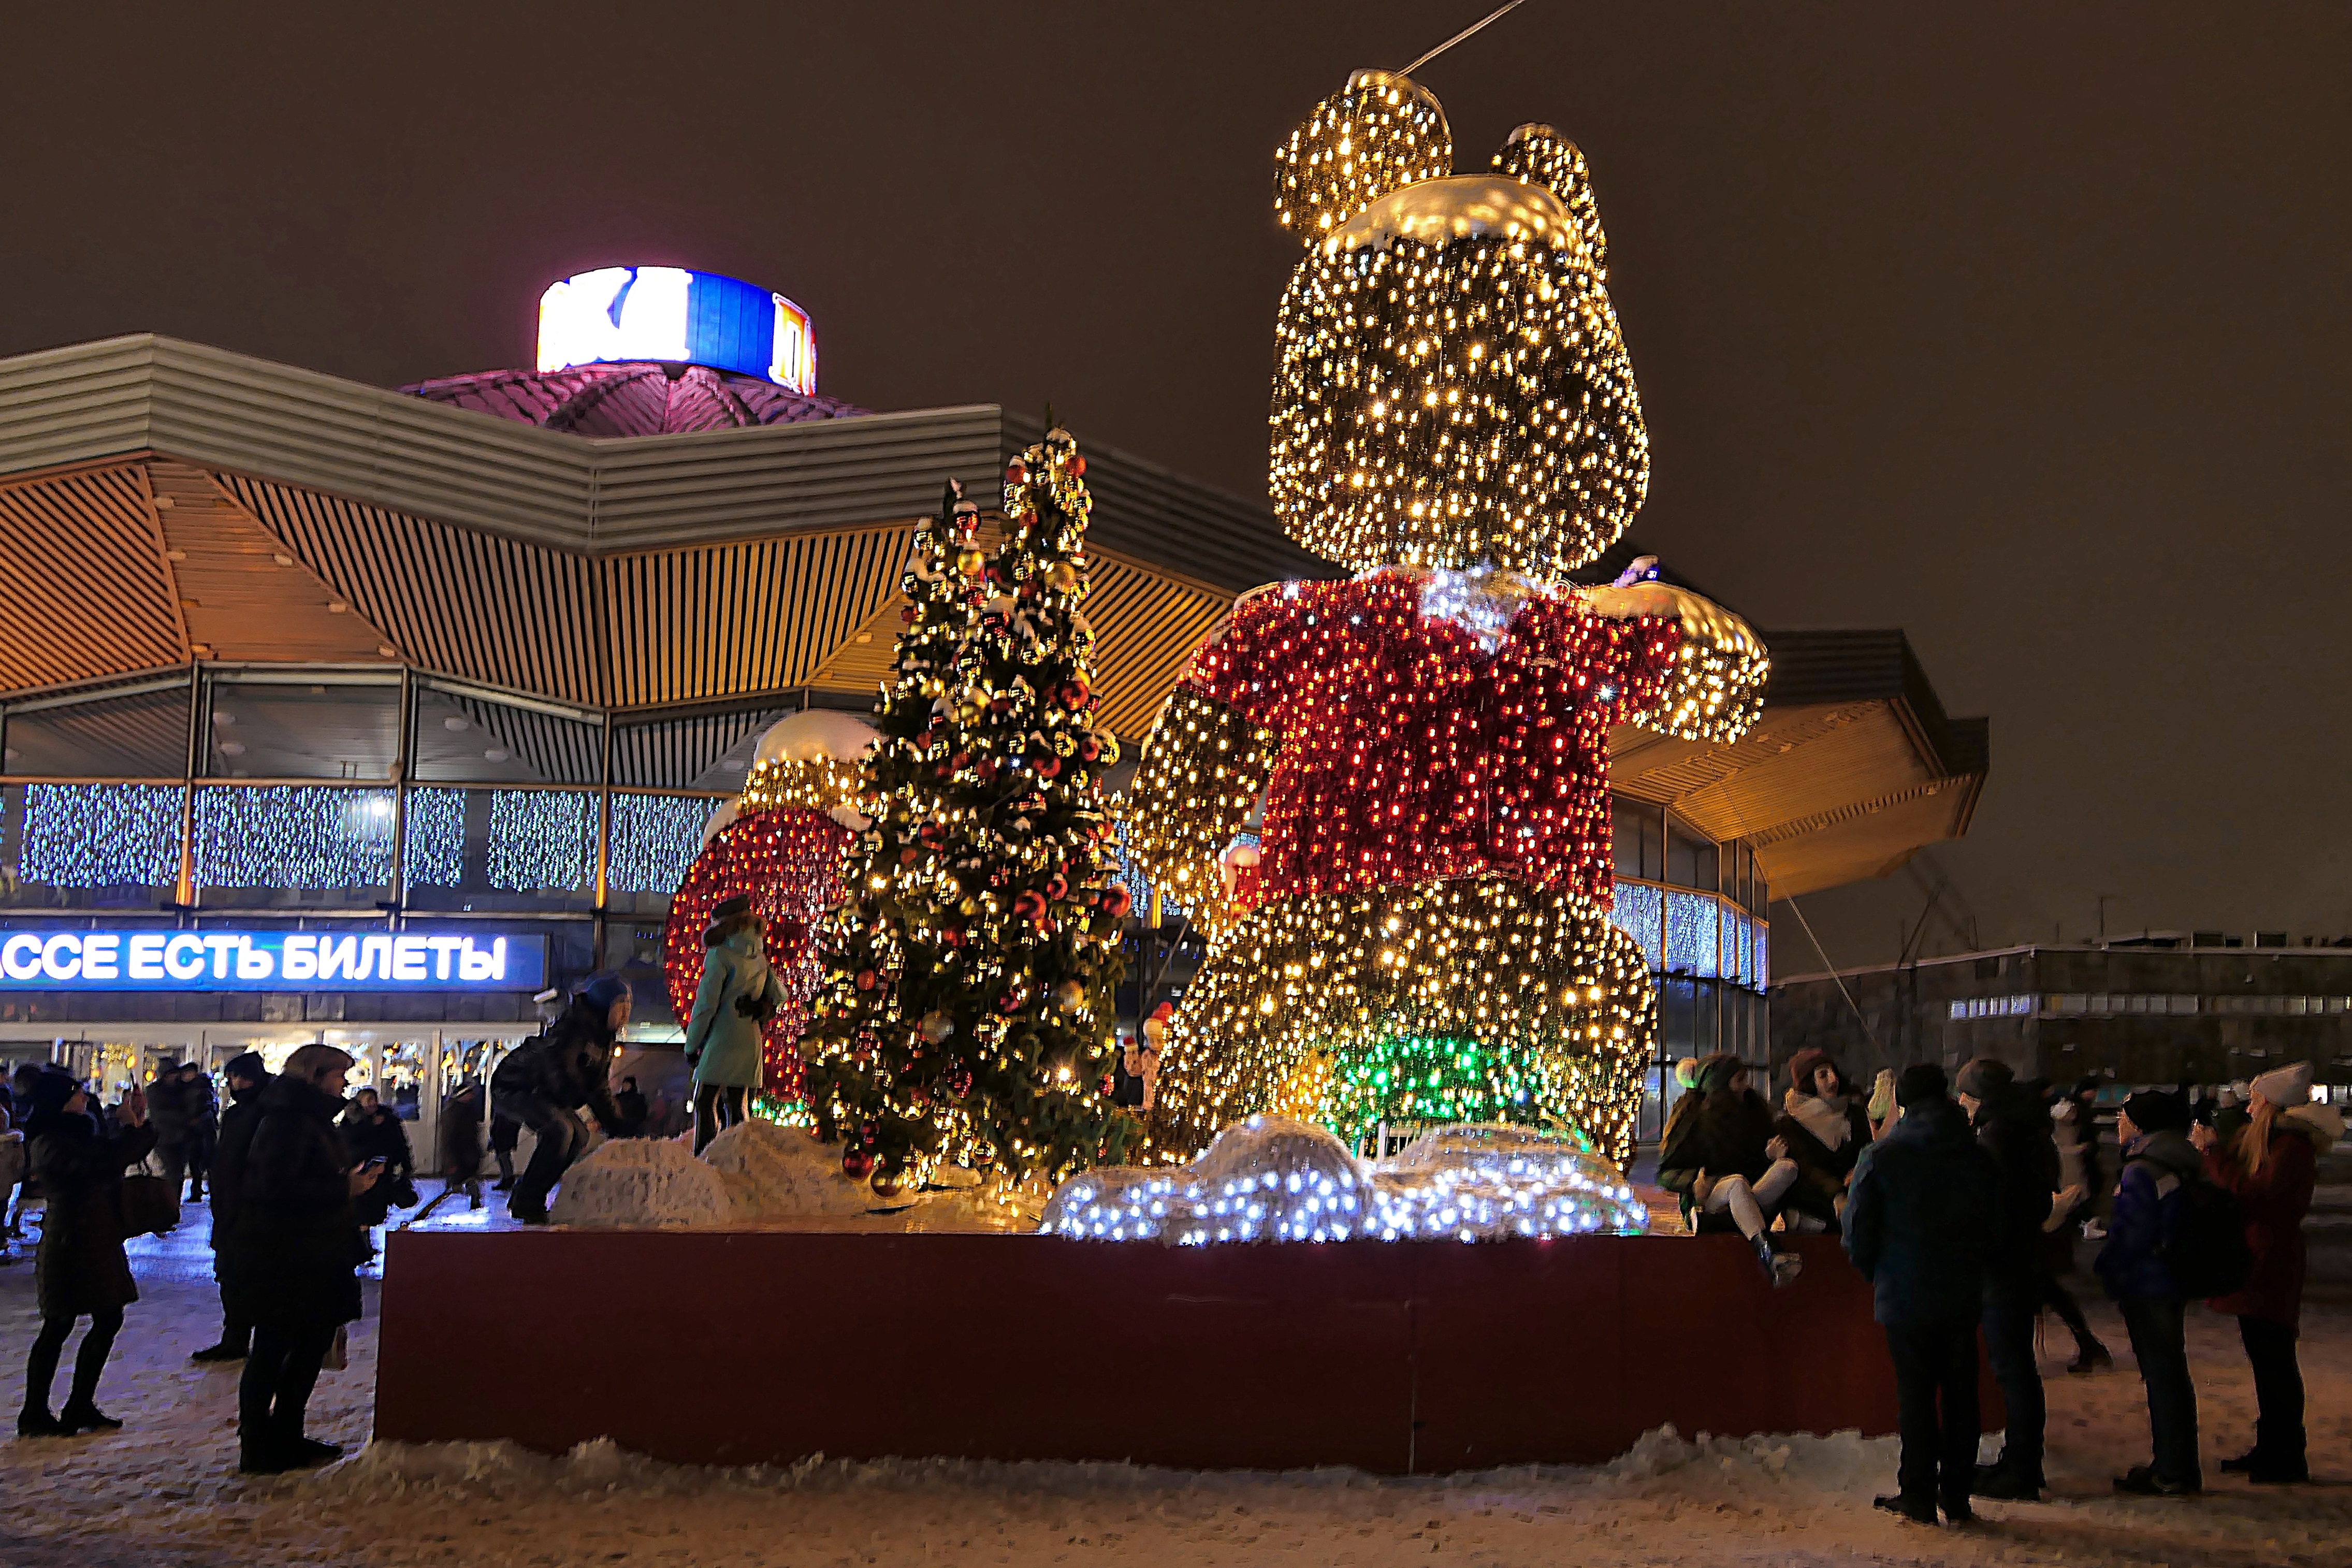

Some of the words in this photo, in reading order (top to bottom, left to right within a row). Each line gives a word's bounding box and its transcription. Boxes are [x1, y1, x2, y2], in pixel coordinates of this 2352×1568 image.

[0, 934, 120, 980] ССЕ
[128, 934, 273, 979] ЕСТЬ
[282, 935, 506, 980] БИЛЕТЫ
